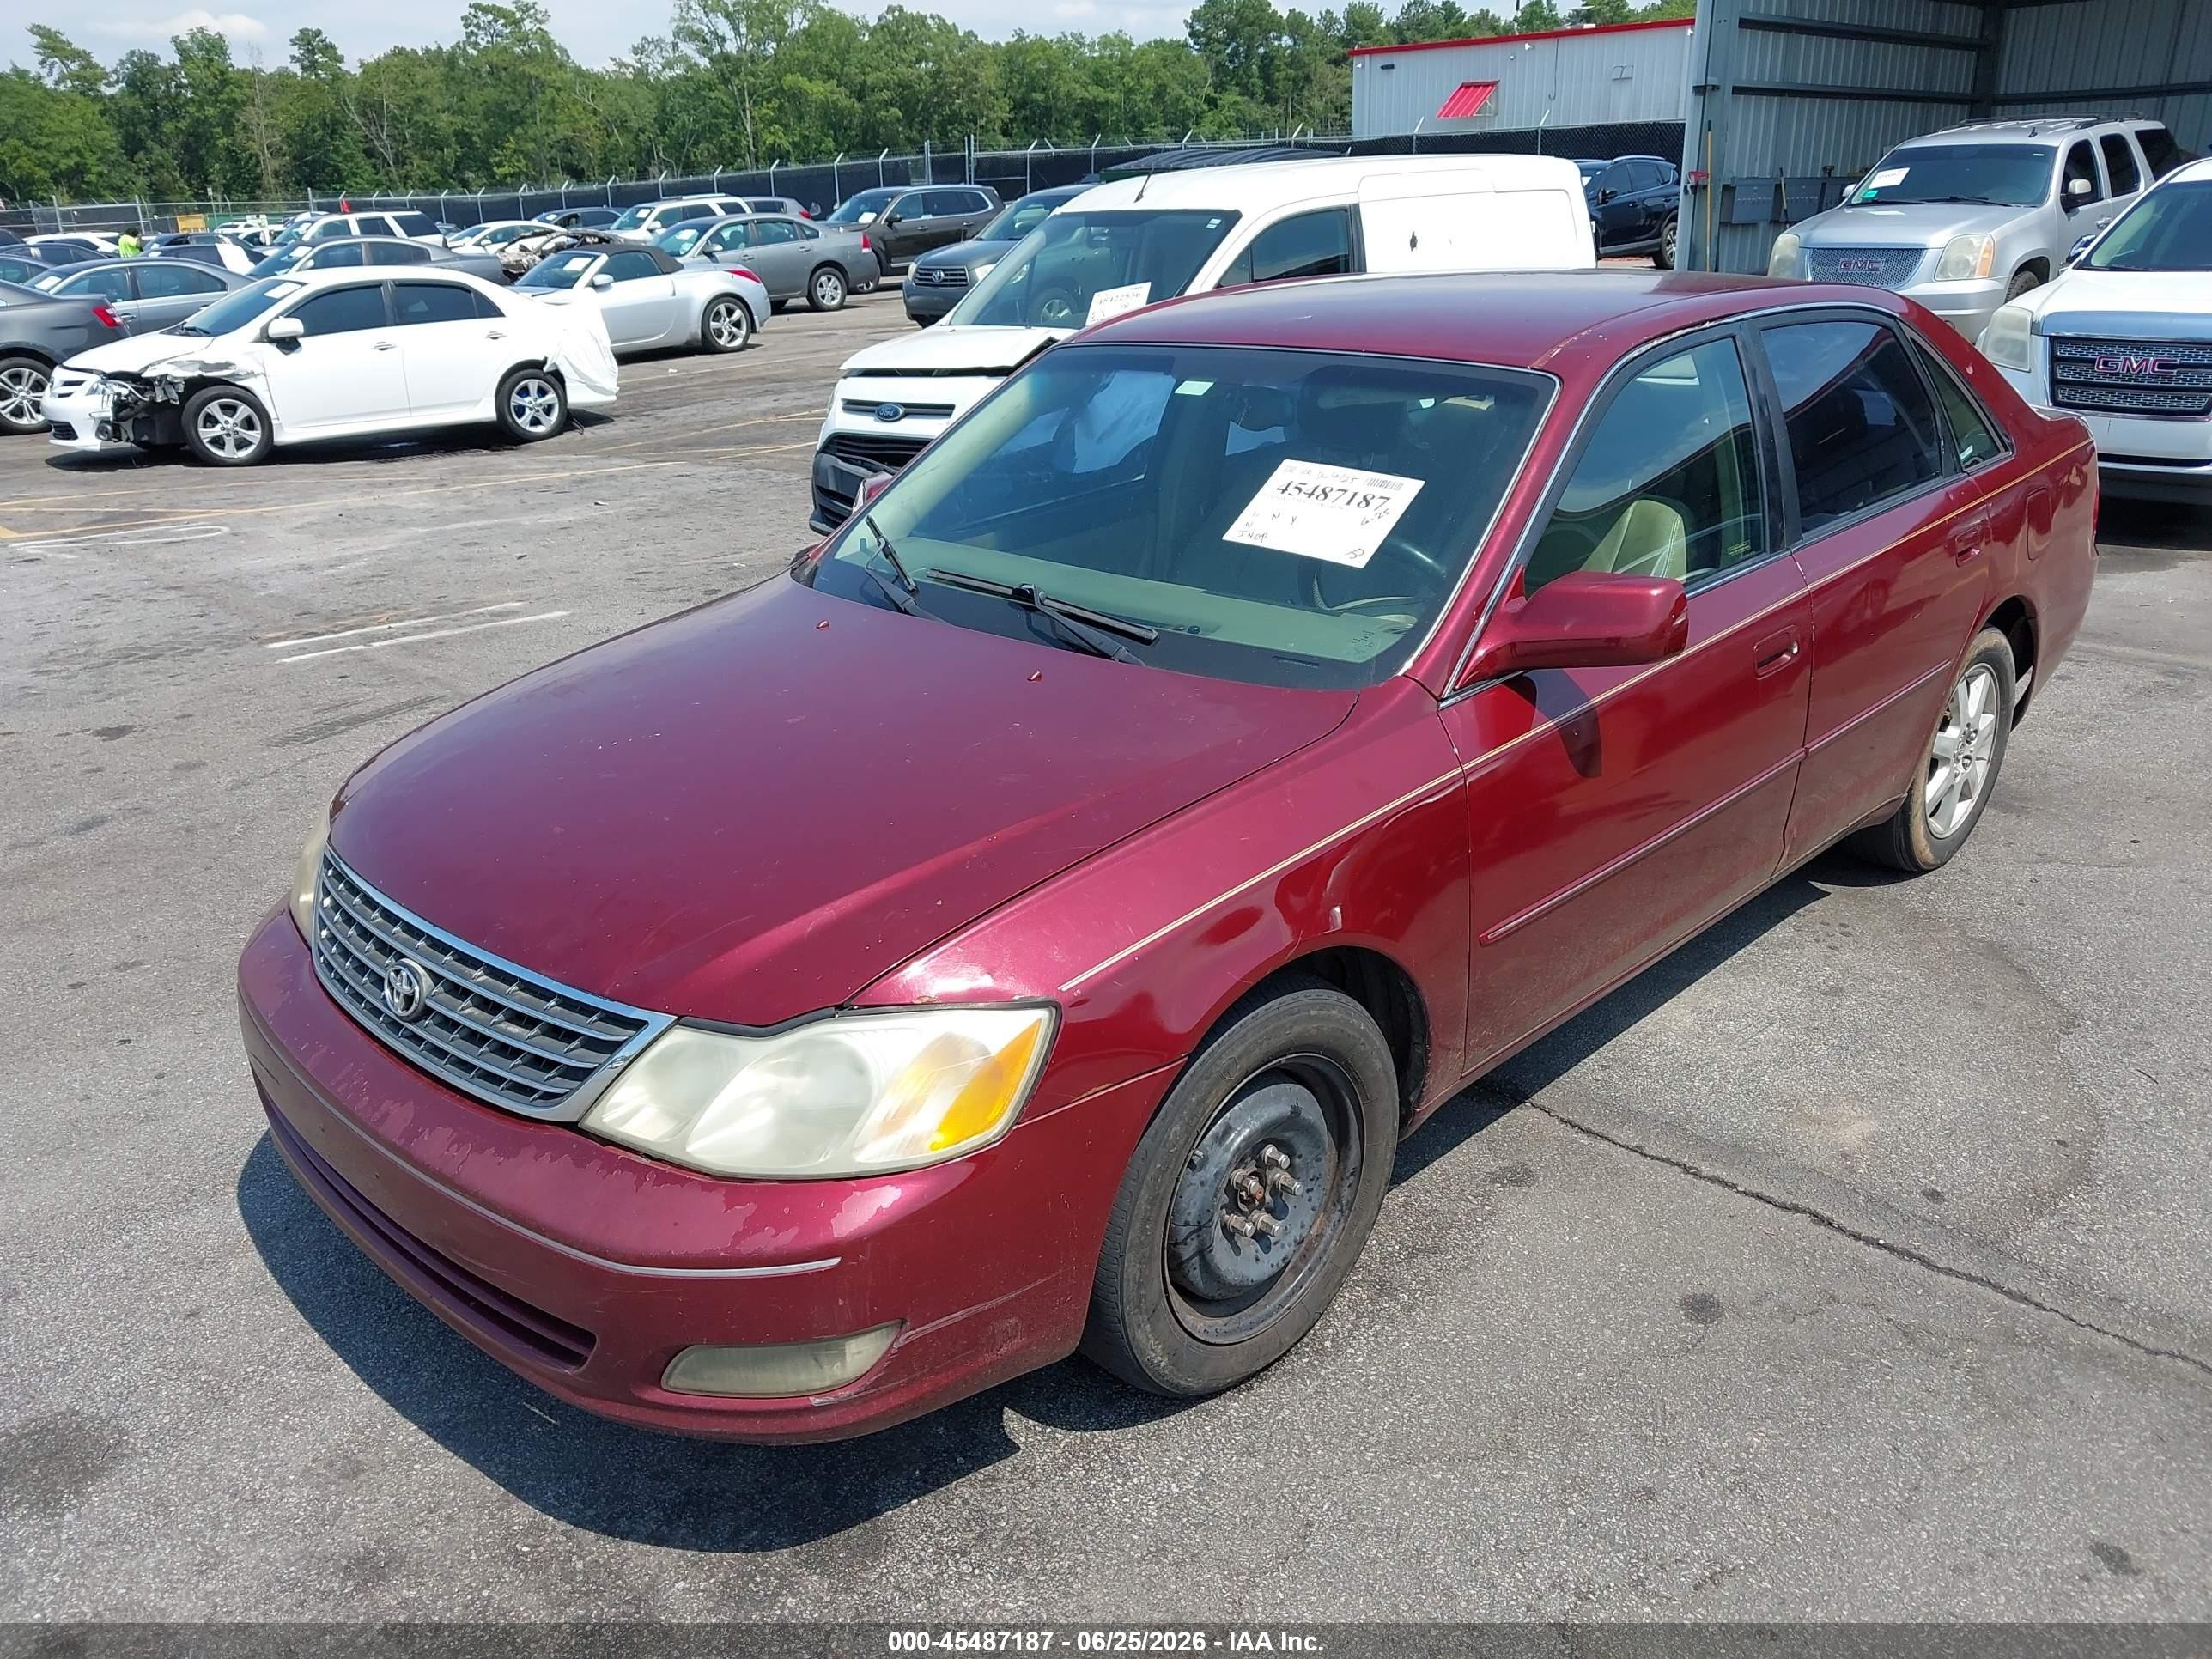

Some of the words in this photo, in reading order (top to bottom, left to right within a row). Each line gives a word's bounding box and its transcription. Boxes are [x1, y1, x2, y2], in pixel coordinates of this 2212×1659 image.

[1839, 258, 1884, 272] GMC
[2095, 355, 2180, 375] GMC
[1277, 480, 1391, 511] 45487187
